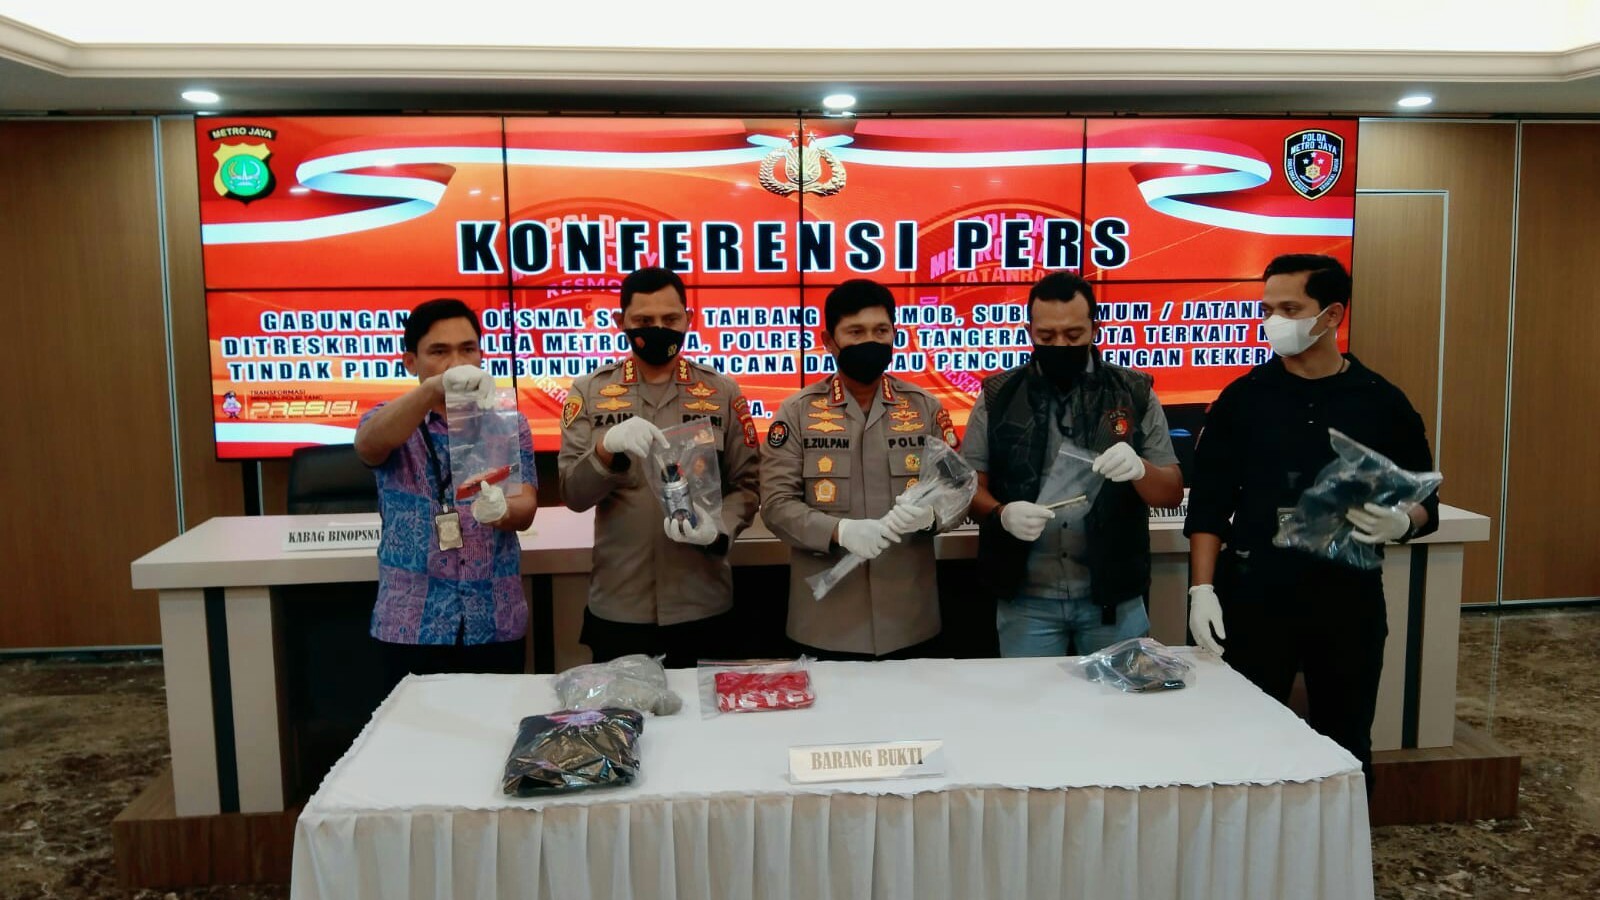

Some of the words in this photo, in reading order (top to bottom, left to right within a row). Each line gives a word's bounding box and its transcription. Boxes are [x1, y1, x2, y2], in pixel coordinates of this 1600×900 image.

[212, 127, 247, 139] METRO
[248, 127, 272, 139] JAYA
[1302, 133, 1327, 142] POLDA
[1290, 141, 1315, 154] METRO
[1317, 141, 1337, 154] JAYA
[457, 219, 918, 275] KONFERENSI
[953, 217, 1130, 271] PERS
[261, 309, 411, 334] GABUNGAN
[702, 306, 819, 329] TAHBANG
[1158, 301, 1171, 321] /
[542, 332, 633, 354] METRO
[721, 329, 815, 352] POLRES
[1145, 323, 1249, 345] TERKAIT
[228, 359, 332, 382] TINDAK
[249, 401, 358, 419] PRESISI
[803, 437, 850, 449] E.ZULPAN
[888, 435, 926, 449] POLR
[288, 530, 325, 543] KABAG
[328, 529, 380, 542] BINOPSNA
[811, 750, 873, 770] BARANG
[877, 747, 923, 767] BUKTI
